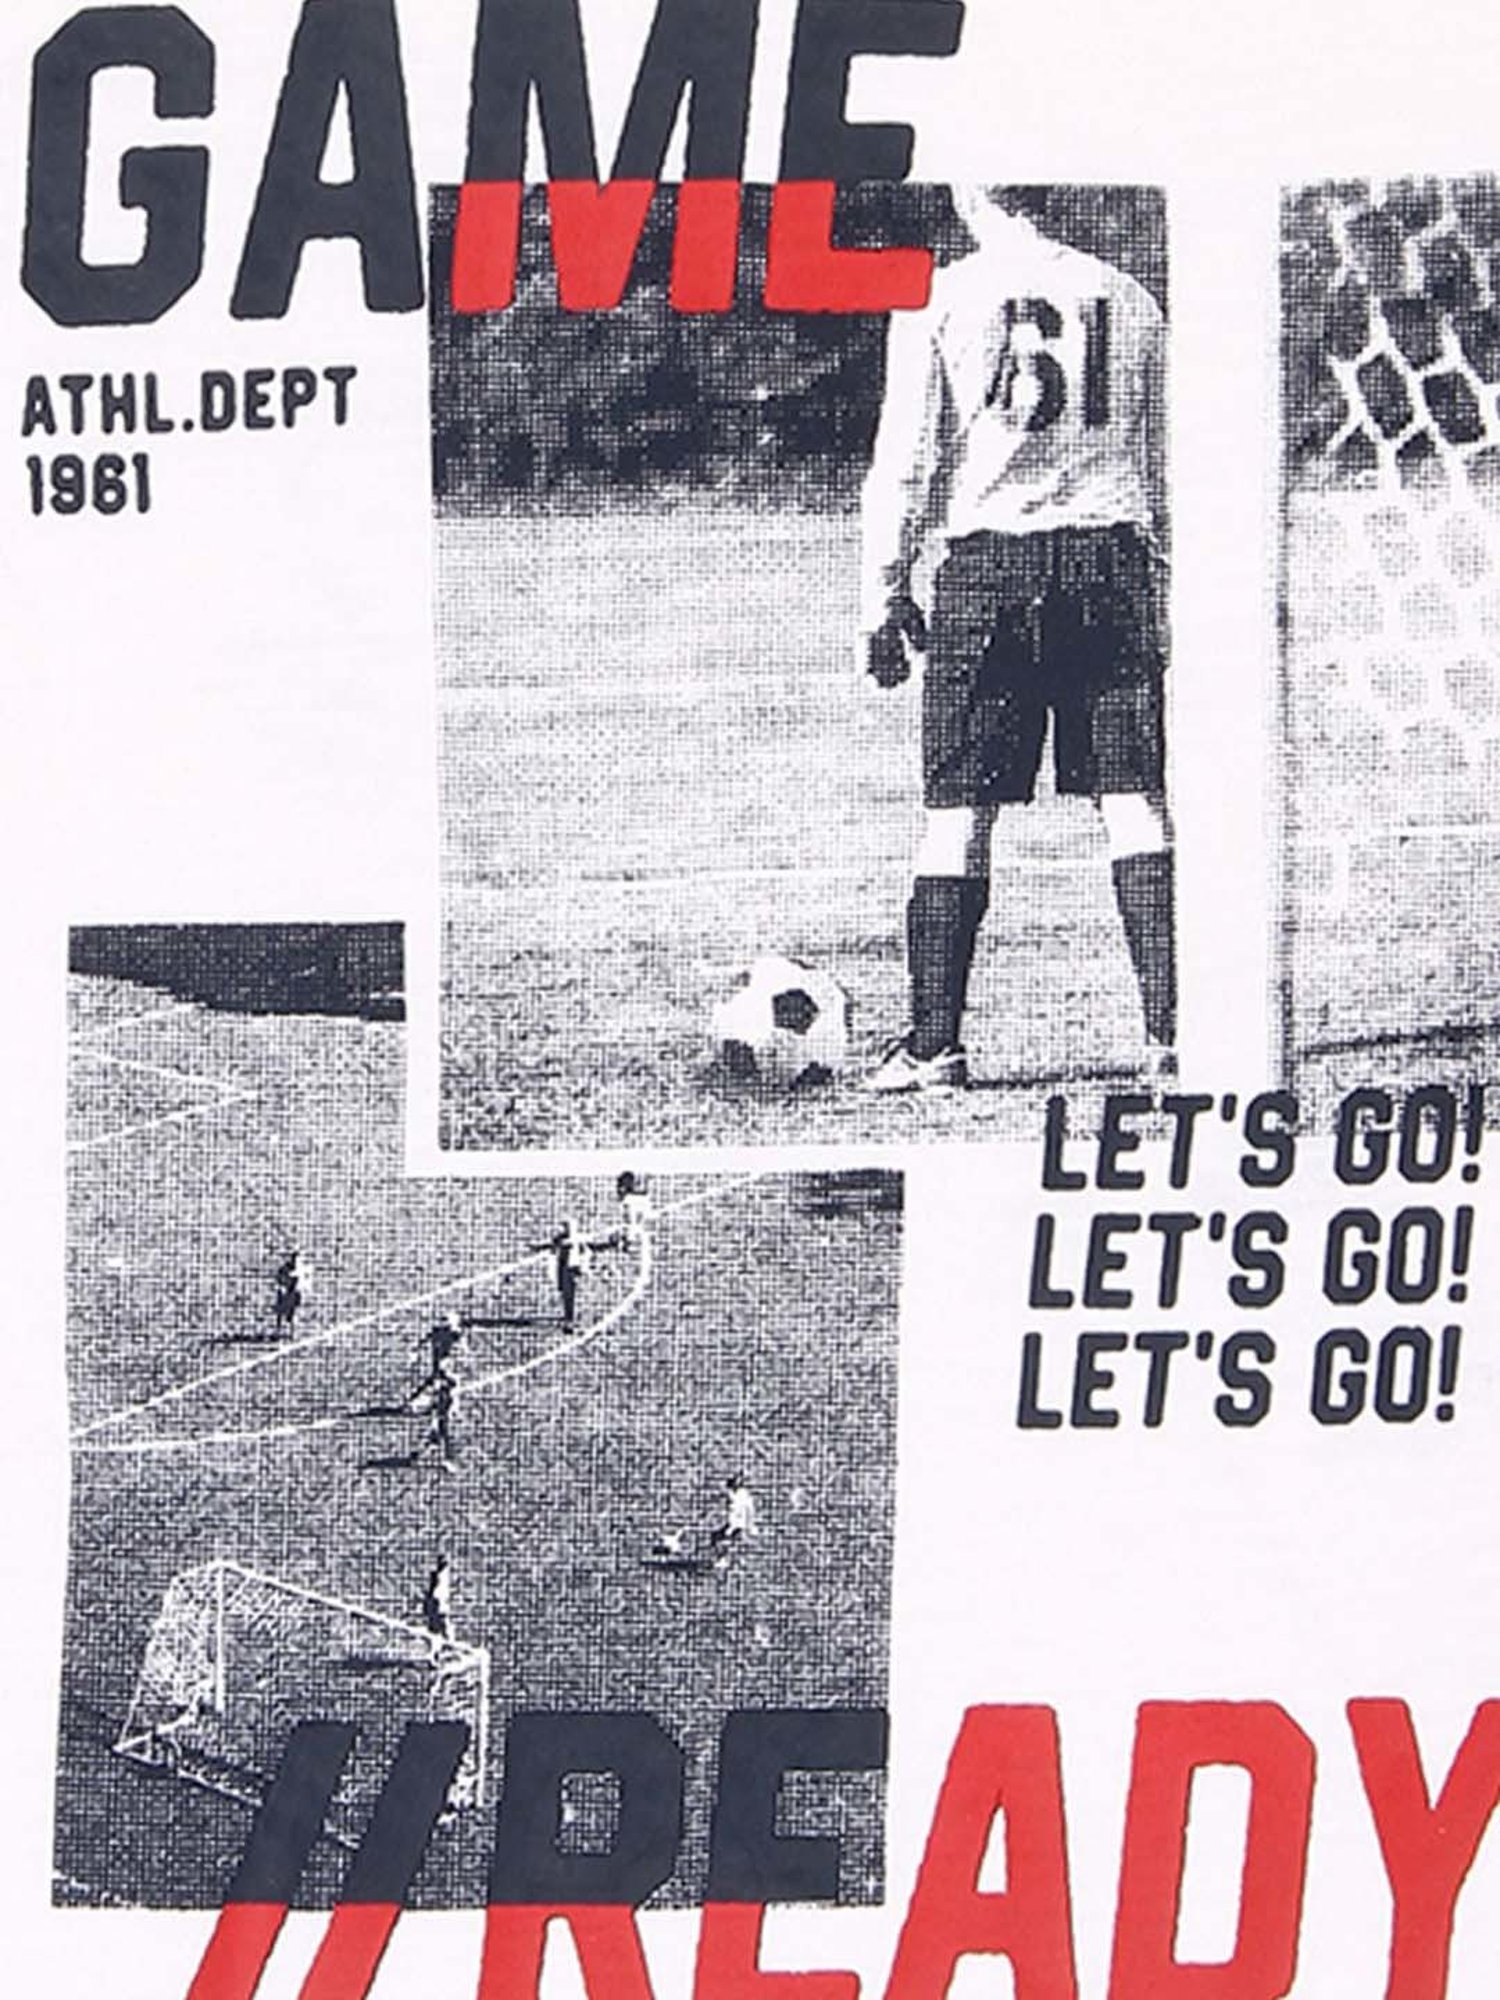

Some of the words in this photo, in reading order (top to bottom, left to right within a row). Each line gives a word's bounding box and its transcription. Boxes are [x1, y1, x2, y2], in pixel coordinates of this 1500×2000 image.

[21, 0, 966, 326] GAME
[21, 366, 358, 437] ATHL.DEPT
[26, 452, 150, 515] 1961
[1041, 1089, 1299, 1190] LET'S
[1333, 1083, 1485, 1186] GO!
[1028, 1211, 1289, 1309] LET'S
[1322, 1205, 1475, 1305] GO!
[1016, 1330, 1276, 1429] LET'S
[1310, 1325, 1463, 1425] GO!
